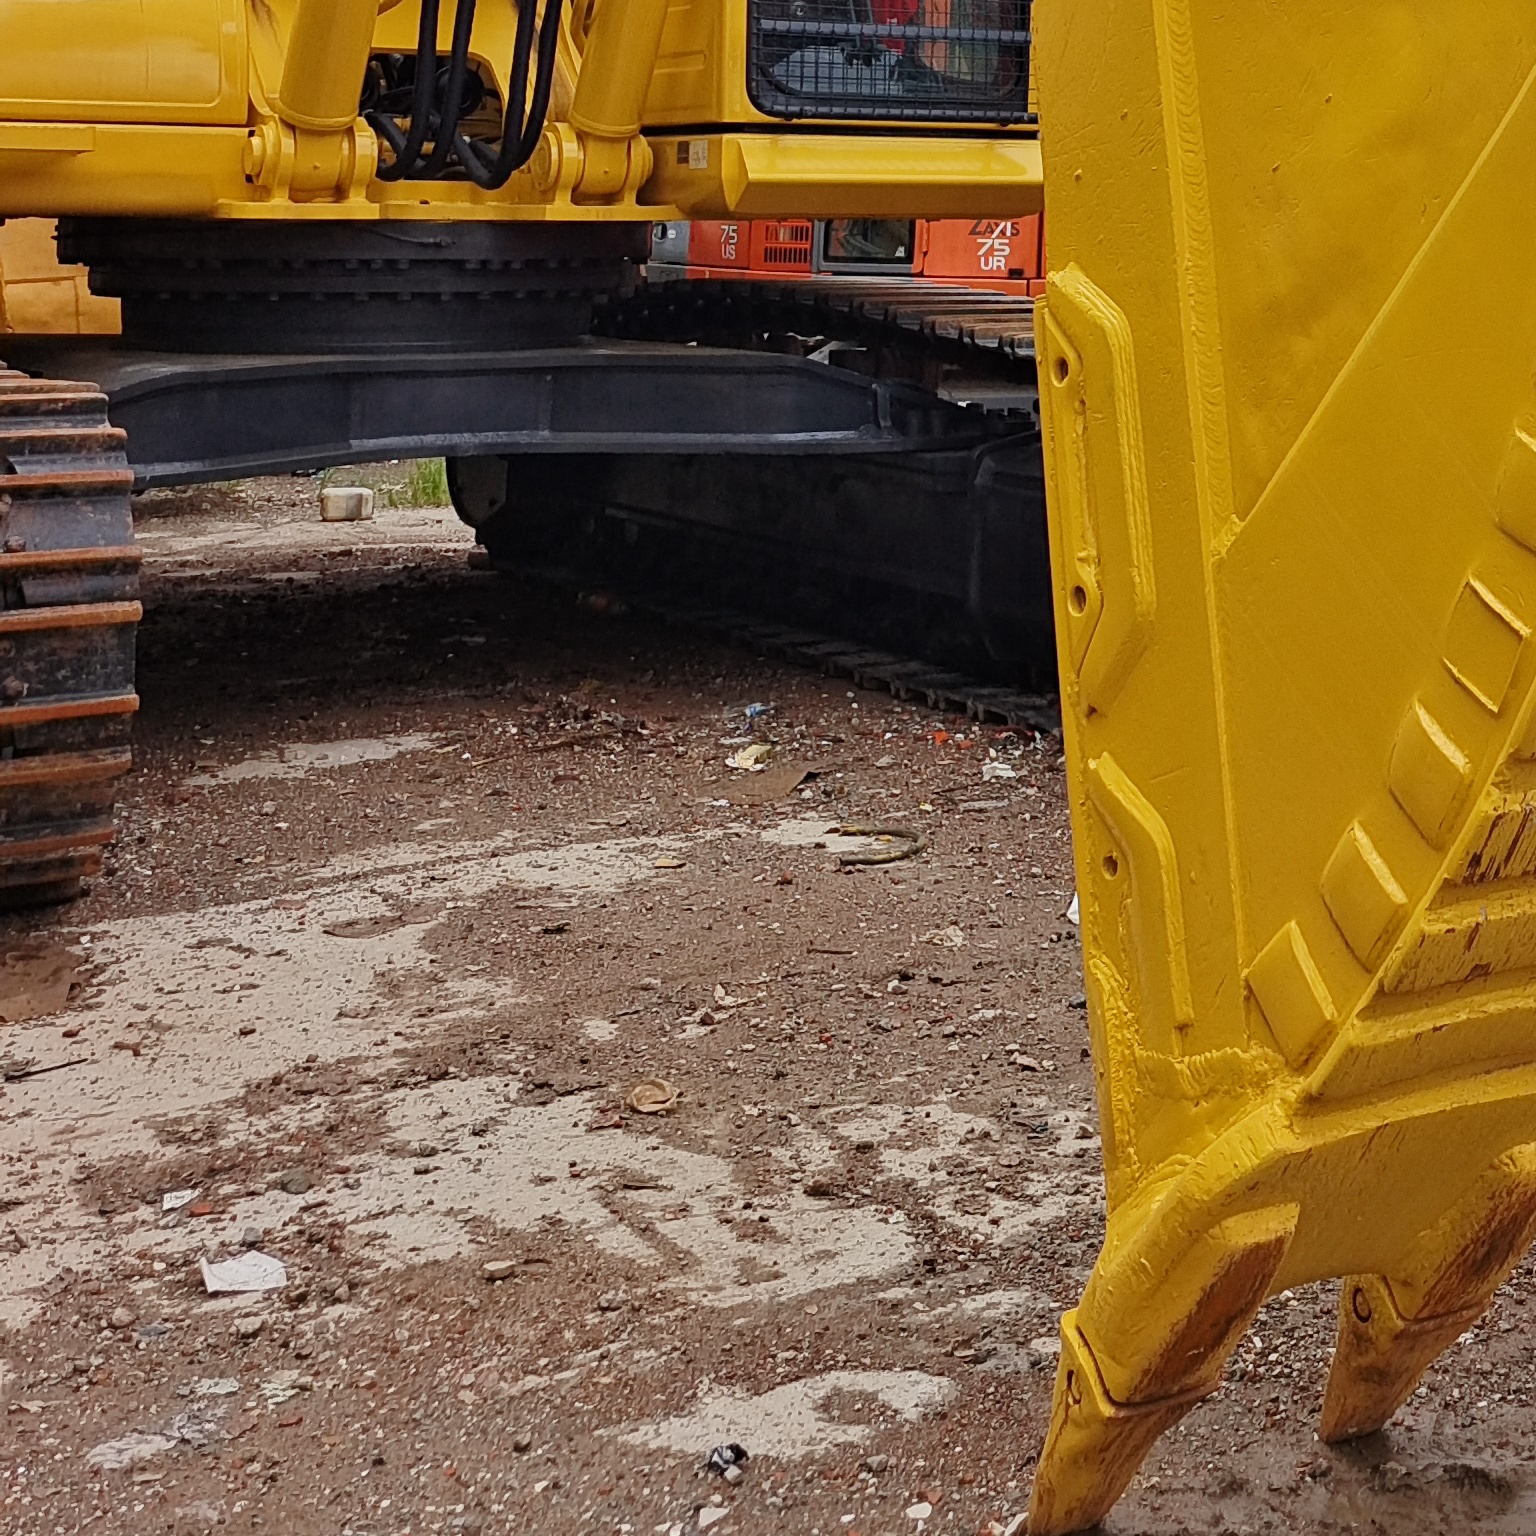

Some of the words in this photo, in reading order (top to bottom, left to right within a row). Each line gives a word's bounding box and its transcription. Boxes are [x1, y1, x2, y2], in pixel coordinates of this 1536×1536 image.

[720, 225, 739, 245] 75
[976, 238, 1011, 257] 75
[980, 256, 1006, 271] UR
